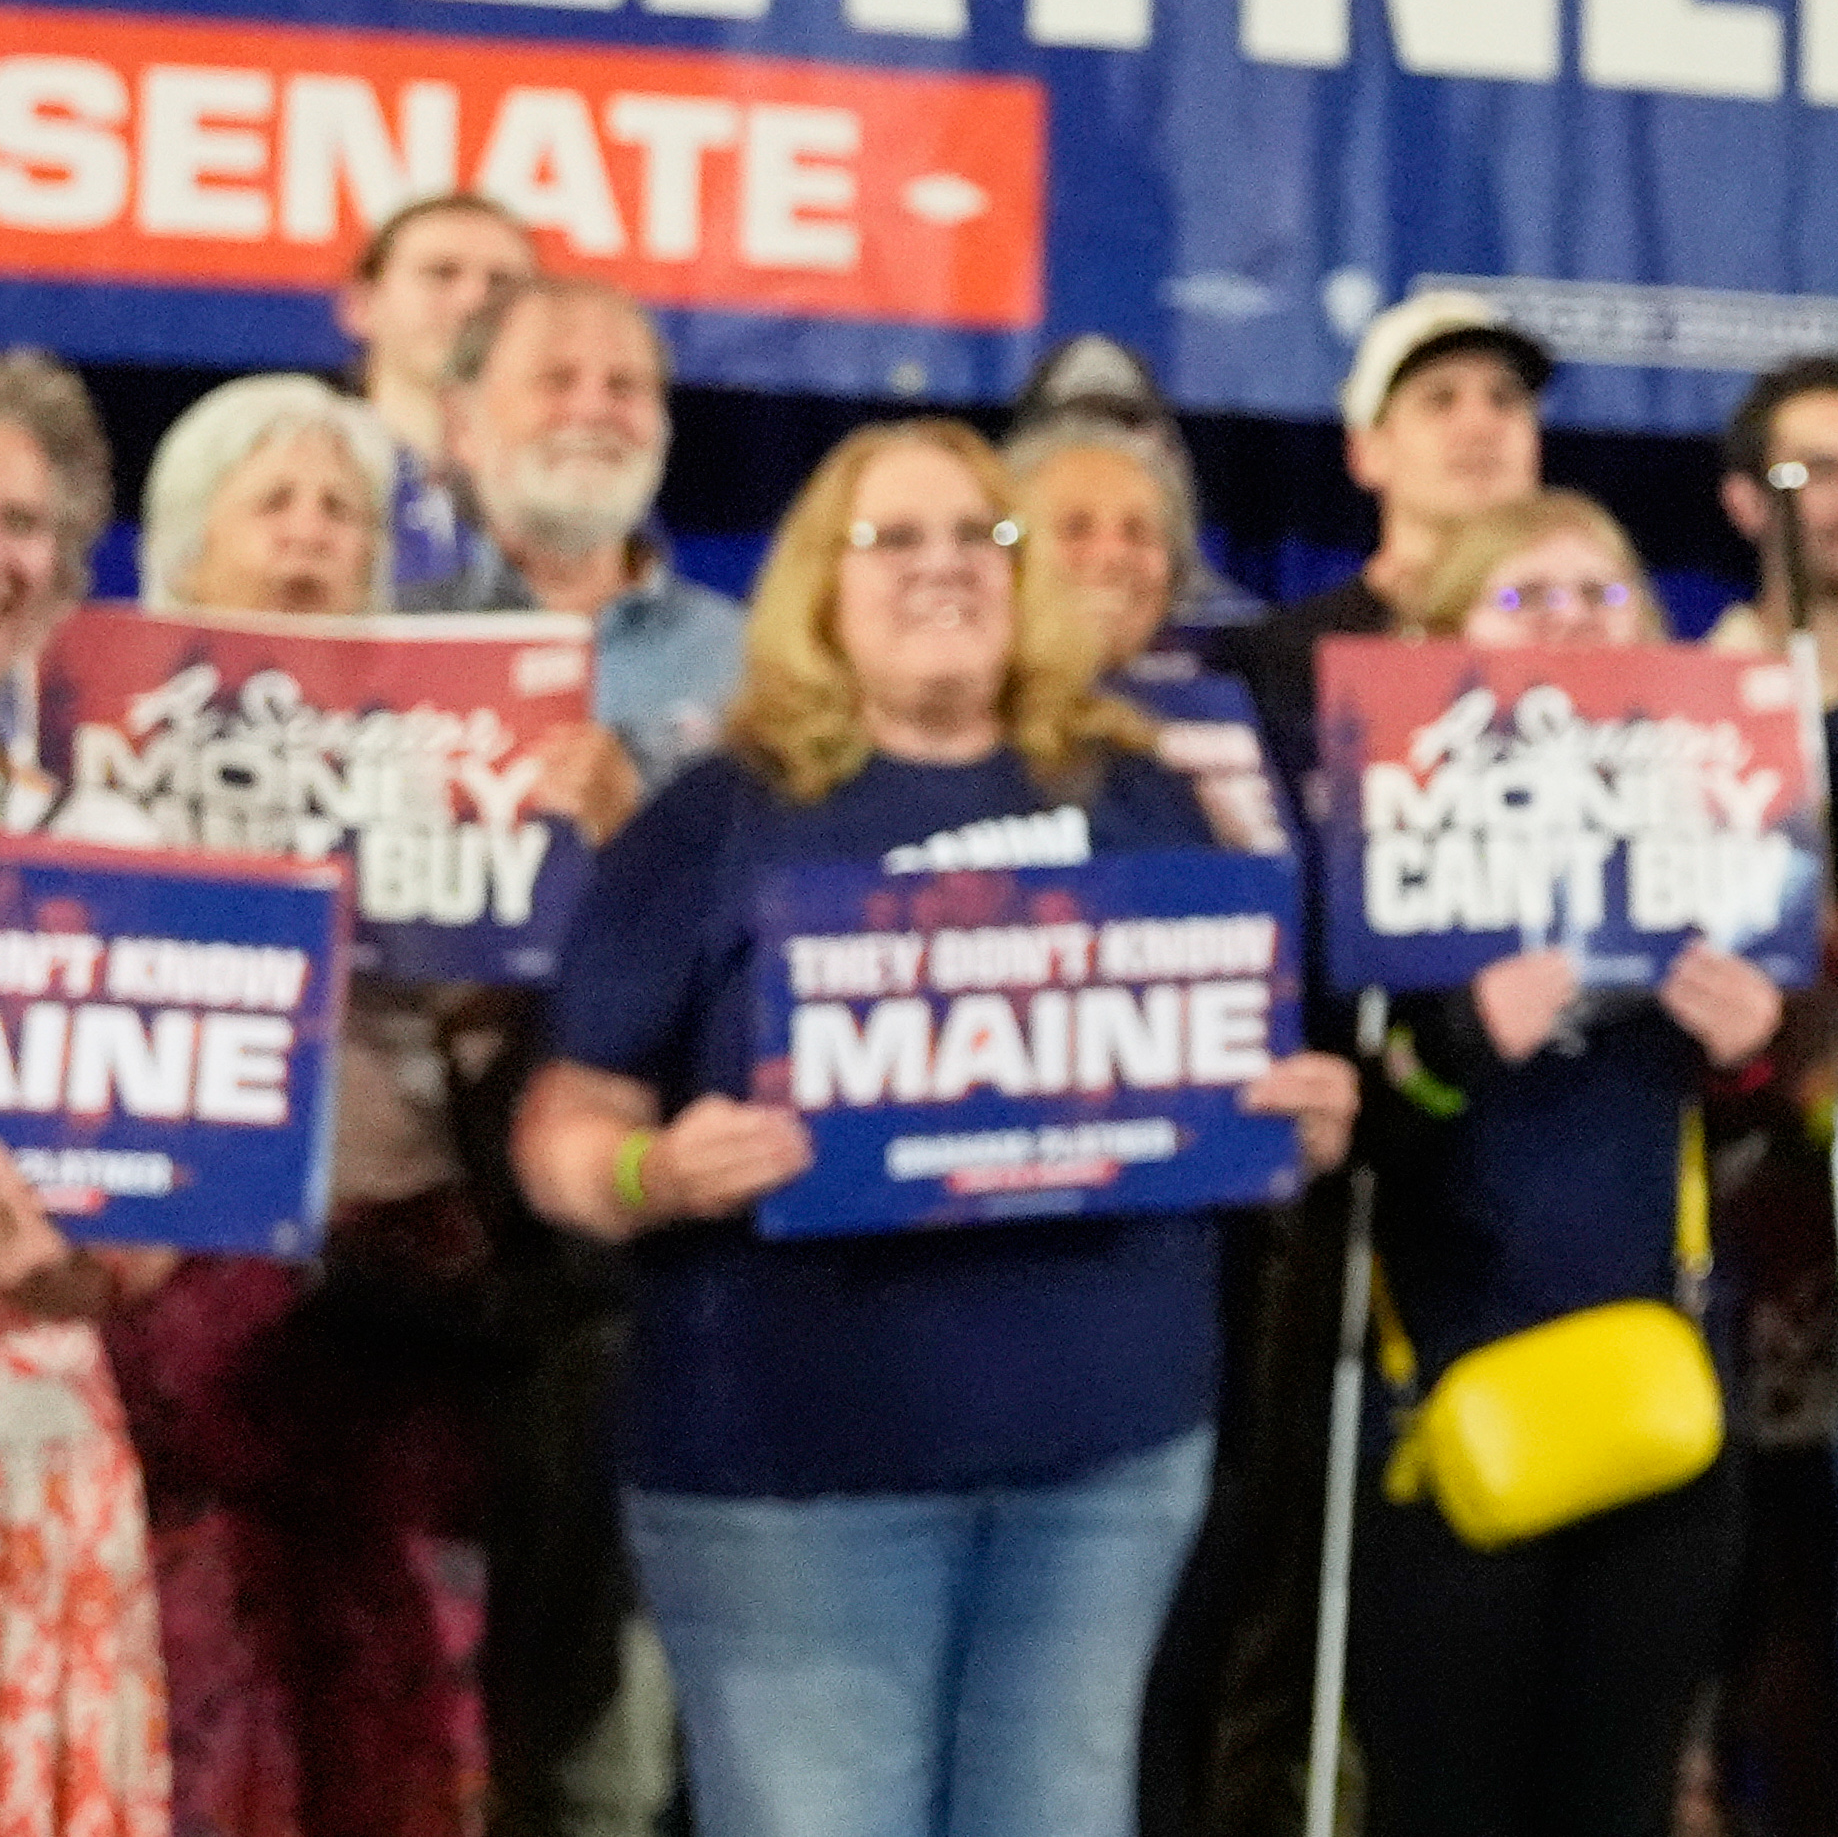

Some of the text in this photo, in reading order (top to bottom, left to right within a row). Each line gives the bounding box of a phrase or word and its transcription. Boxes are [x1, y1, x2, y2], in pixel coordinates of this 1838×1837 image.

[0, 52, 863, 272] SENATE
[72, 722, 545, 834] MONEY
[1362, 758, 1784, 842] MONEY
[357, 820, 552, 926] BUY
[0, 998, 296, 1126] INE
[791, 979, 1272, 1110] MAINE
